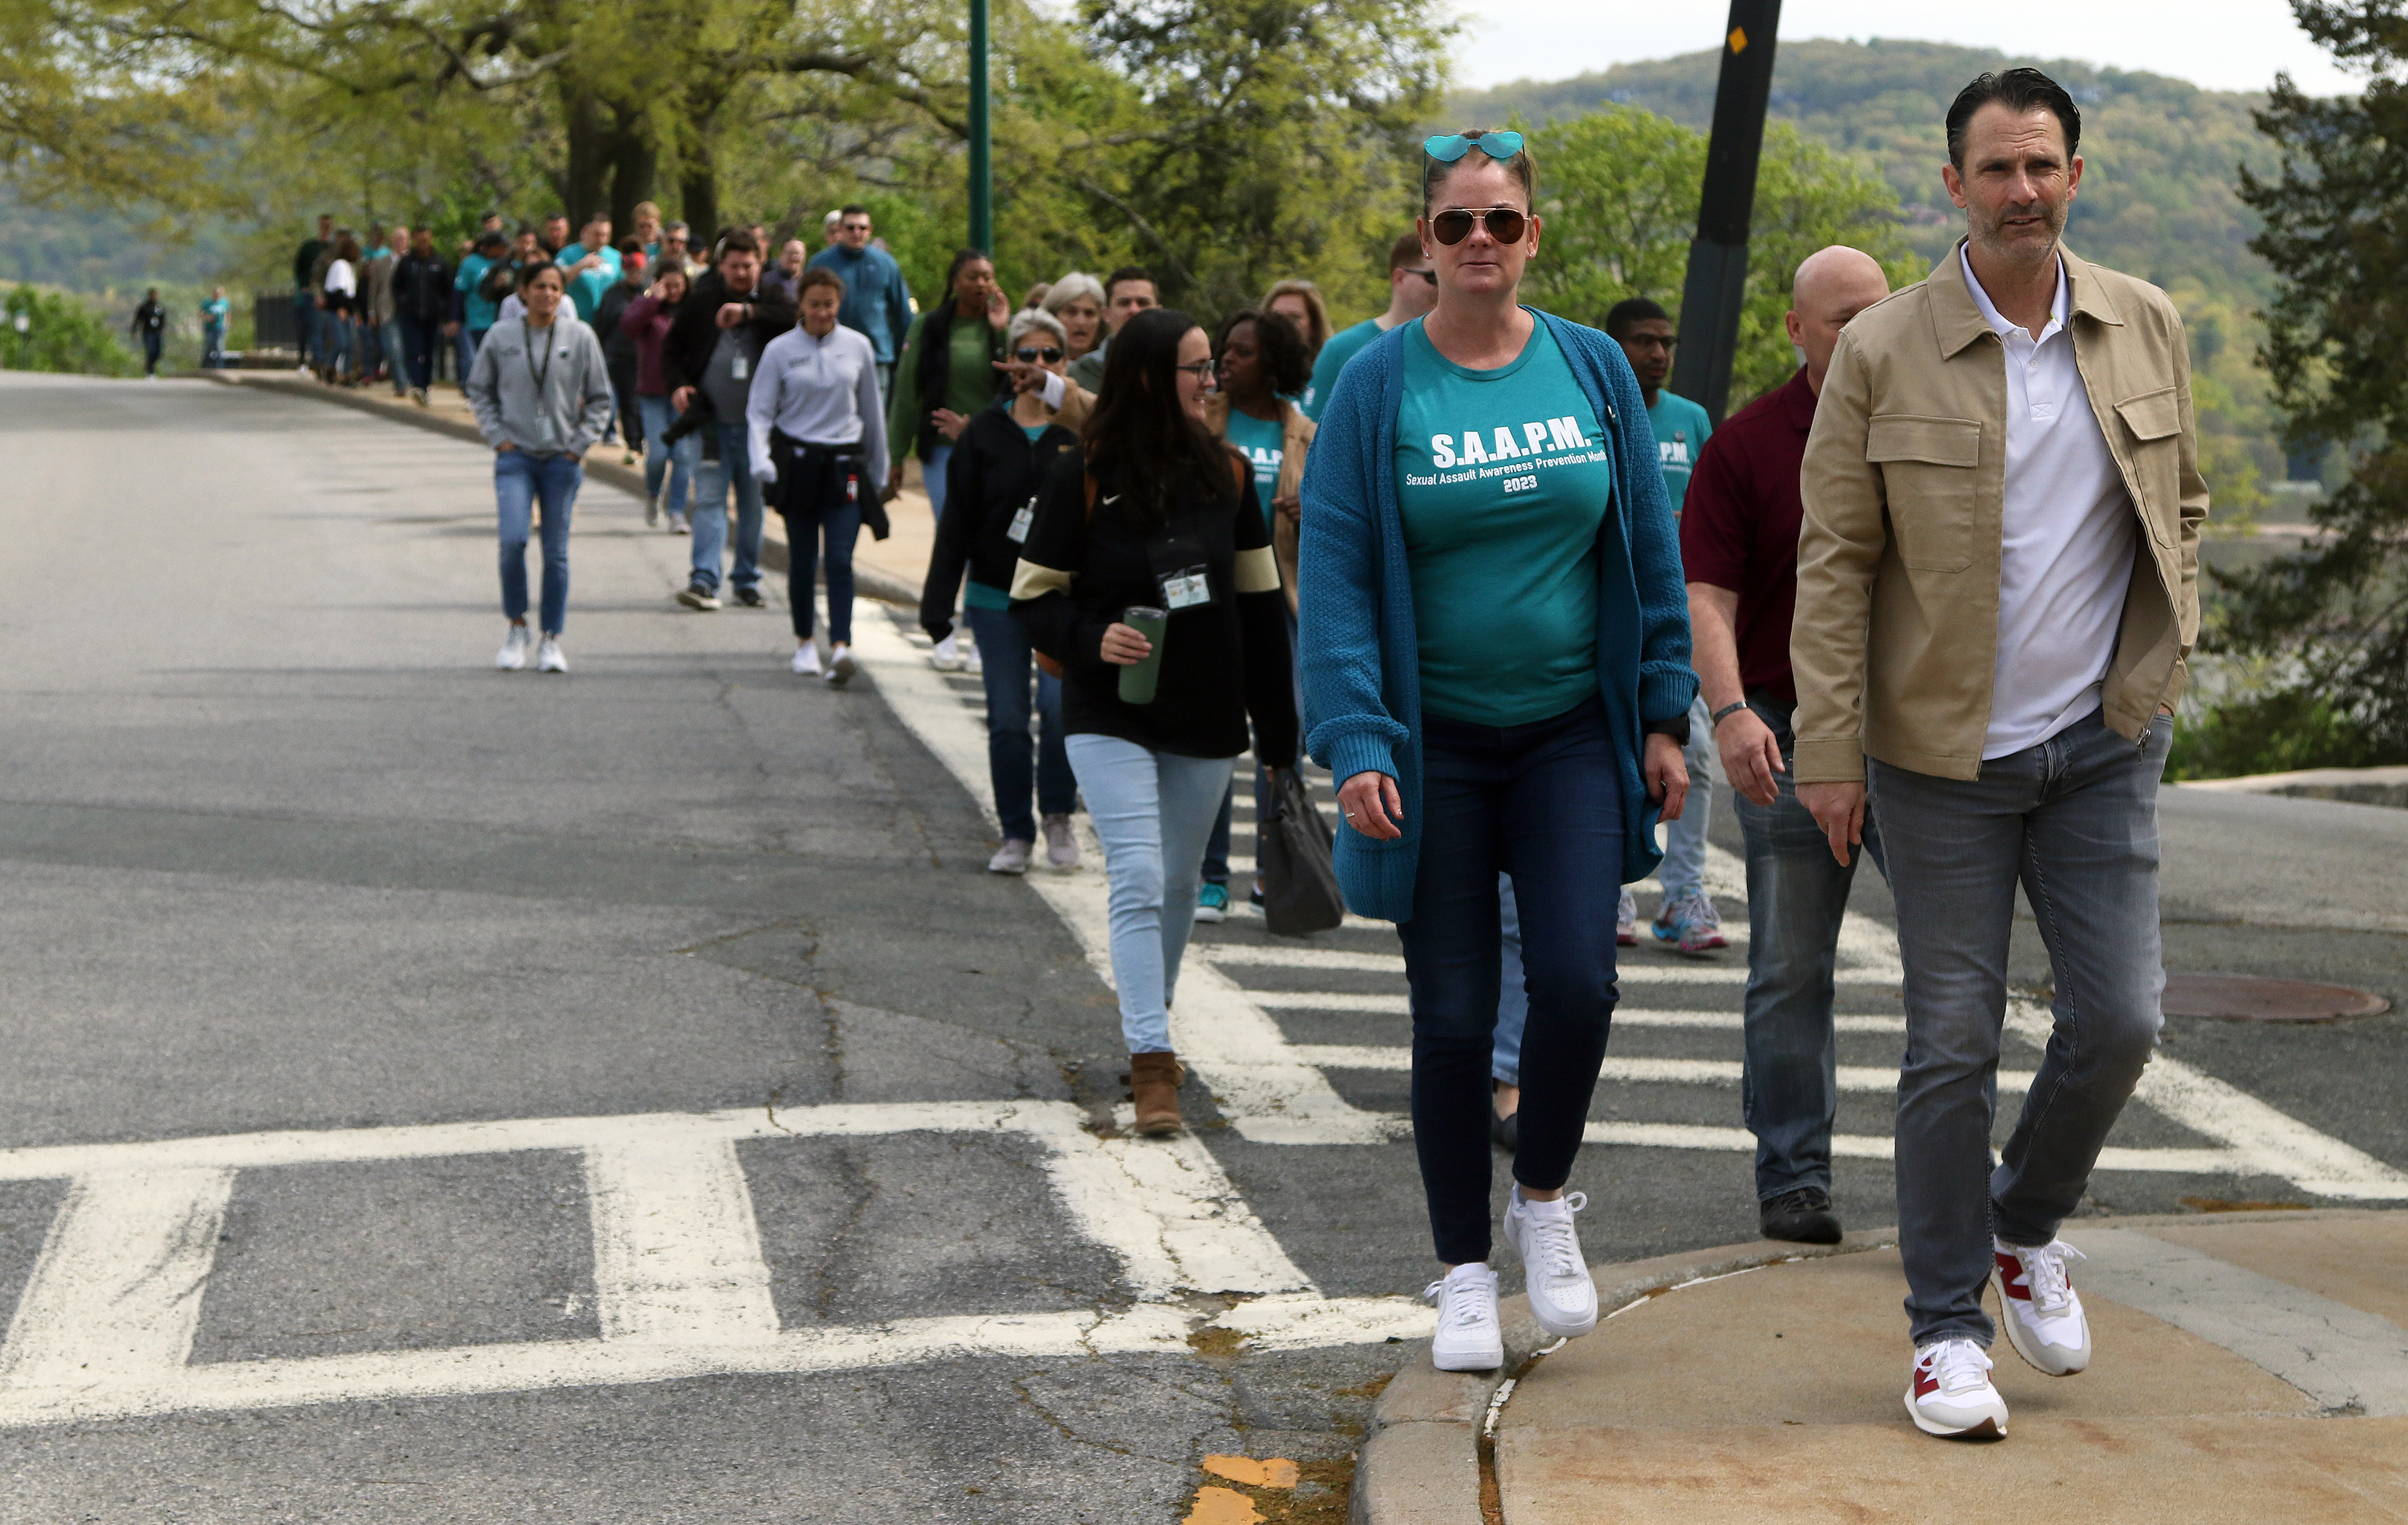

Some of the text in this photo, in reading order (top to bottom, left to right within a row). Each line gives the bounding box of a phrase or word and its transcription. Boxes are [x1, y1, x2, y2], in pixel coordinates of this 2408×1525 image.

[1432, 416, 1592, 468] S.A.A.P.M.
[1406, 449, 1608, 485] Sexual Assault Awareness Prevention Month
[1503, 474, 1537, 493] 2023
